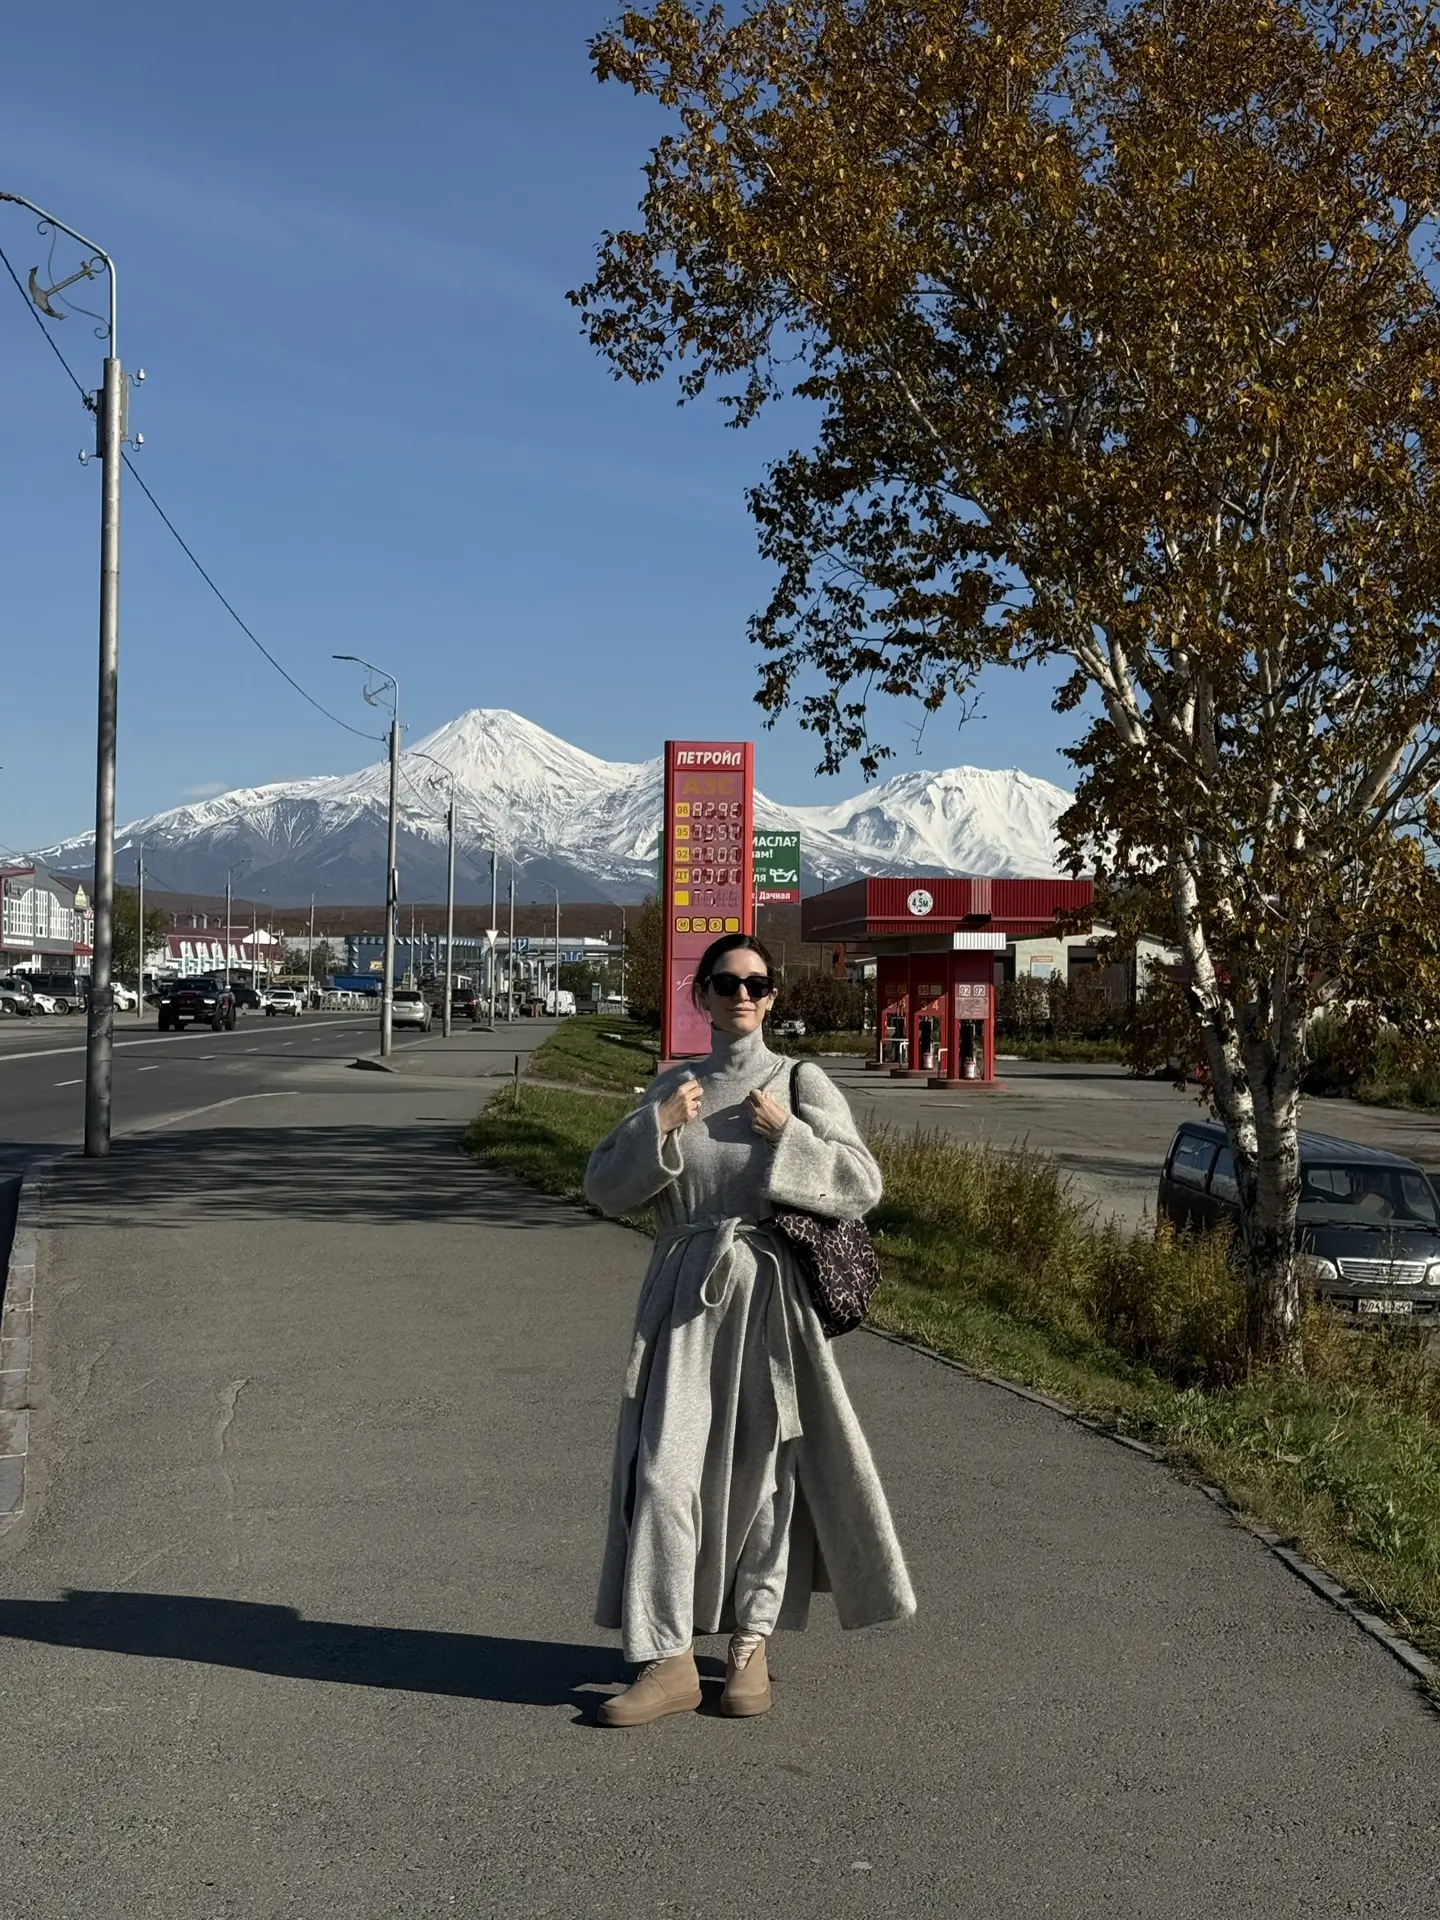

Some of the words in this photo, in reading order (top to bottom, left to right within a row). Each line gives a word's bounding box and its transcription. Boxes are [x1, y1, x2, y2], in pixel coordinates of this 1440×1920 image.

[677, 750, 742, 766] ПЕТРОЙЛ
[683, 777, 735, 796] АЗС
[677, 806, 689, 815] 98
[677, 828, 688, 836] 95
[677, 851, 688, 859] 92
[676, 871, 689, 881] ДТ
[960, 986, 970, 996] 92
[974, 986, 985, 996] 92
[932, 1000, 939, 1011] 4
